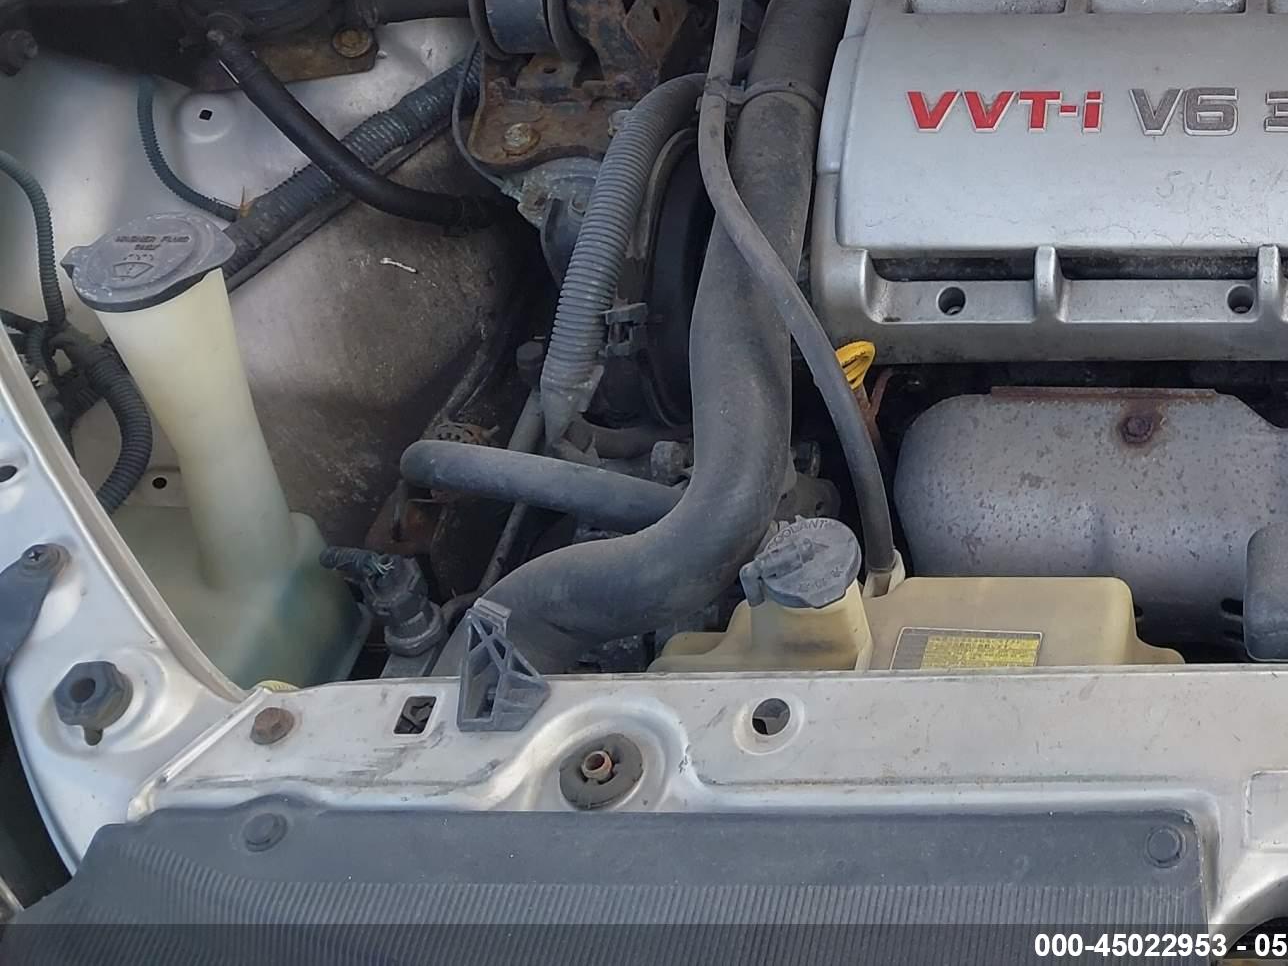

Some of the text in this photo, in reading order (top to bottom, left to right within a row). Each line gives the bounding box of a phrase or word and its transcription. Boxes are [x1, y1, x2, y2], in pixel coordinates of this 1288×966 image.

[907, 89, 1104, 133] VVT-i
[1128, 88, 1239, 136] V6
[160, 235, 192, 243] FLUID
